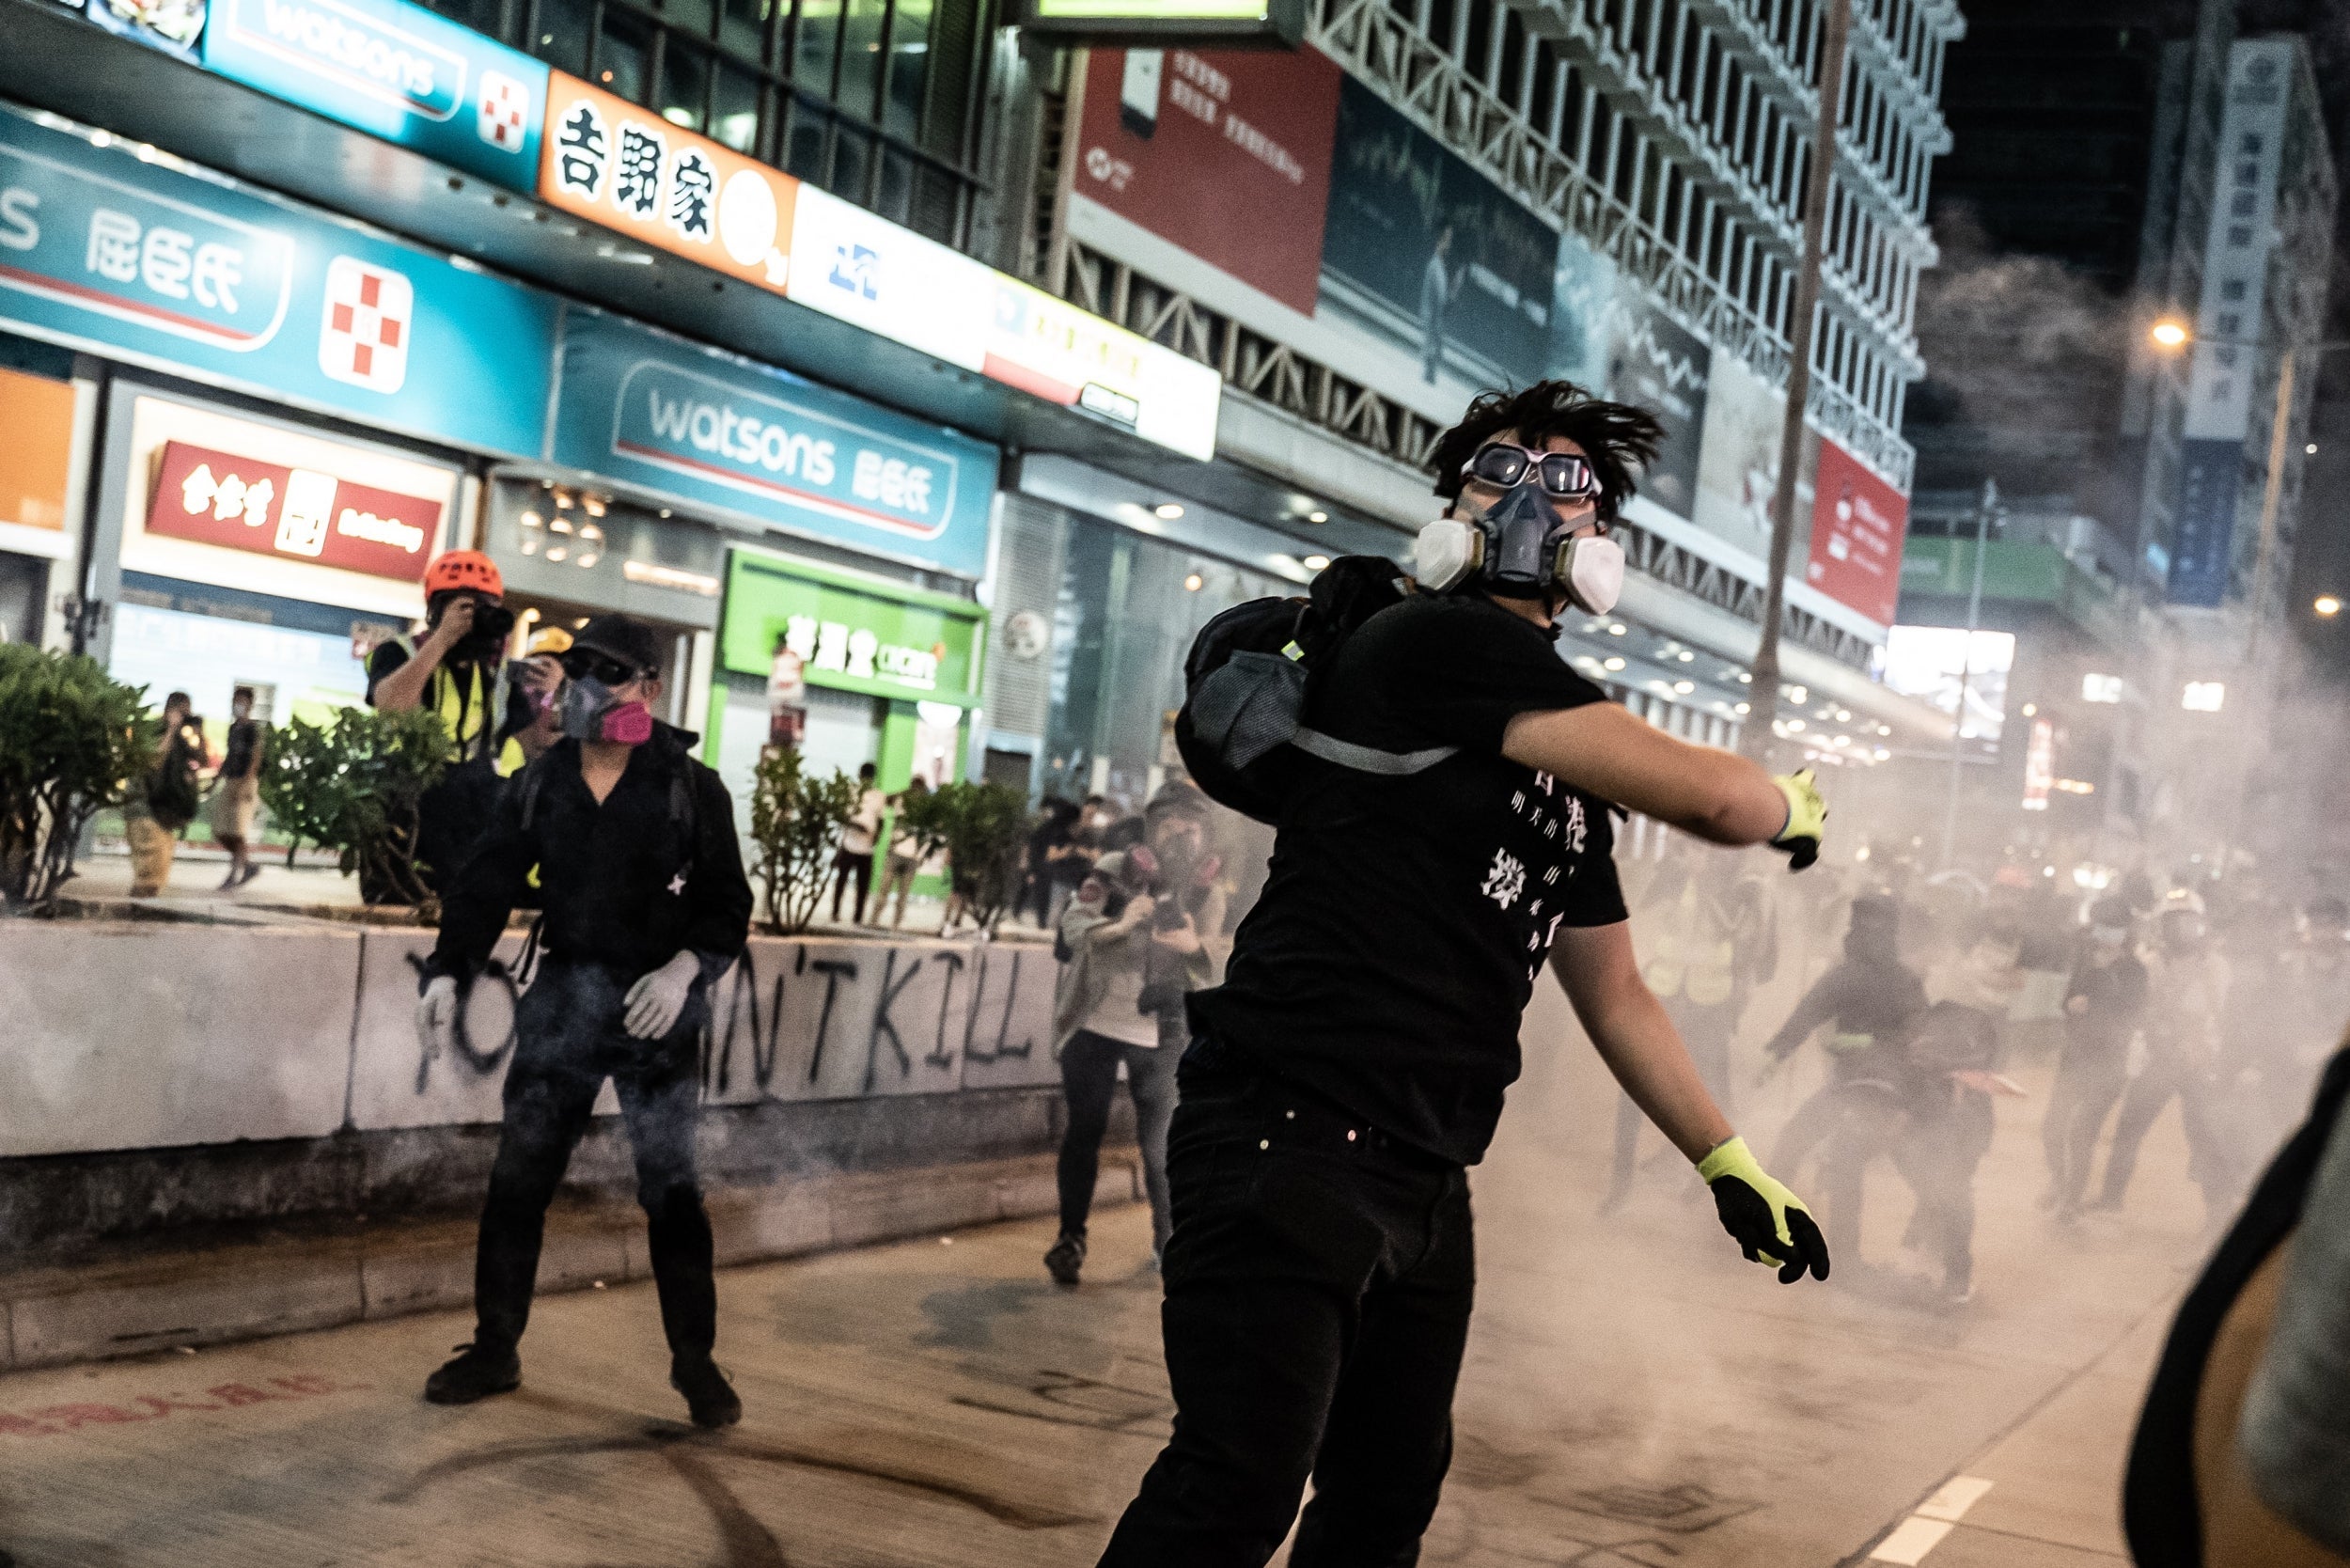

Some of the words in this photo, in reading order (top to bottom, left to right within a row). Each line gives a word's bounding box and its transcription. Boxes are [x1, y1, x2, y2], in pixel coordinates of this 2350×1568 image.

[264, 0, 435, 96] watsons
[557, 104, 715, 240] 吉野家
[86, 207, 245, 315] 屈臣氏
[649, 390, 837, 487] watsons
[851, 448, 933, 515] 屈臣氏
[864, 948, 1032, 1092] KILL
